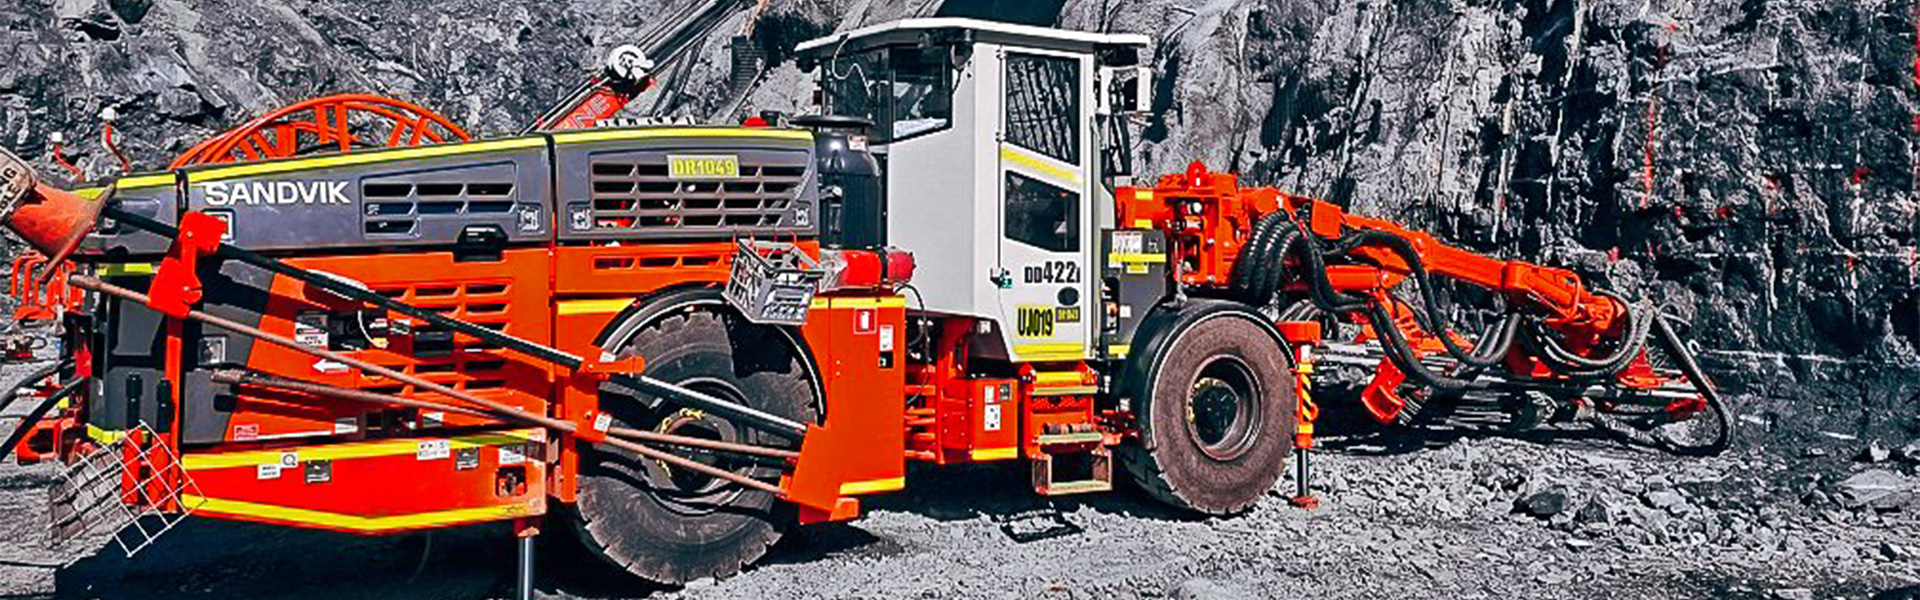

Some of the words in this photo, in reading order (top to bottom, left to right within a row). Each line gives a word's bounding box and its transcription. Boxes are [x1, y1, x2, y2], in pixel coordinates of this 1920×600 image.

[674, 158, 736, 175] DR1049
[204, 181, 351, 206] SANDVIK
[1017, 307, 1053, 337] UJ019
